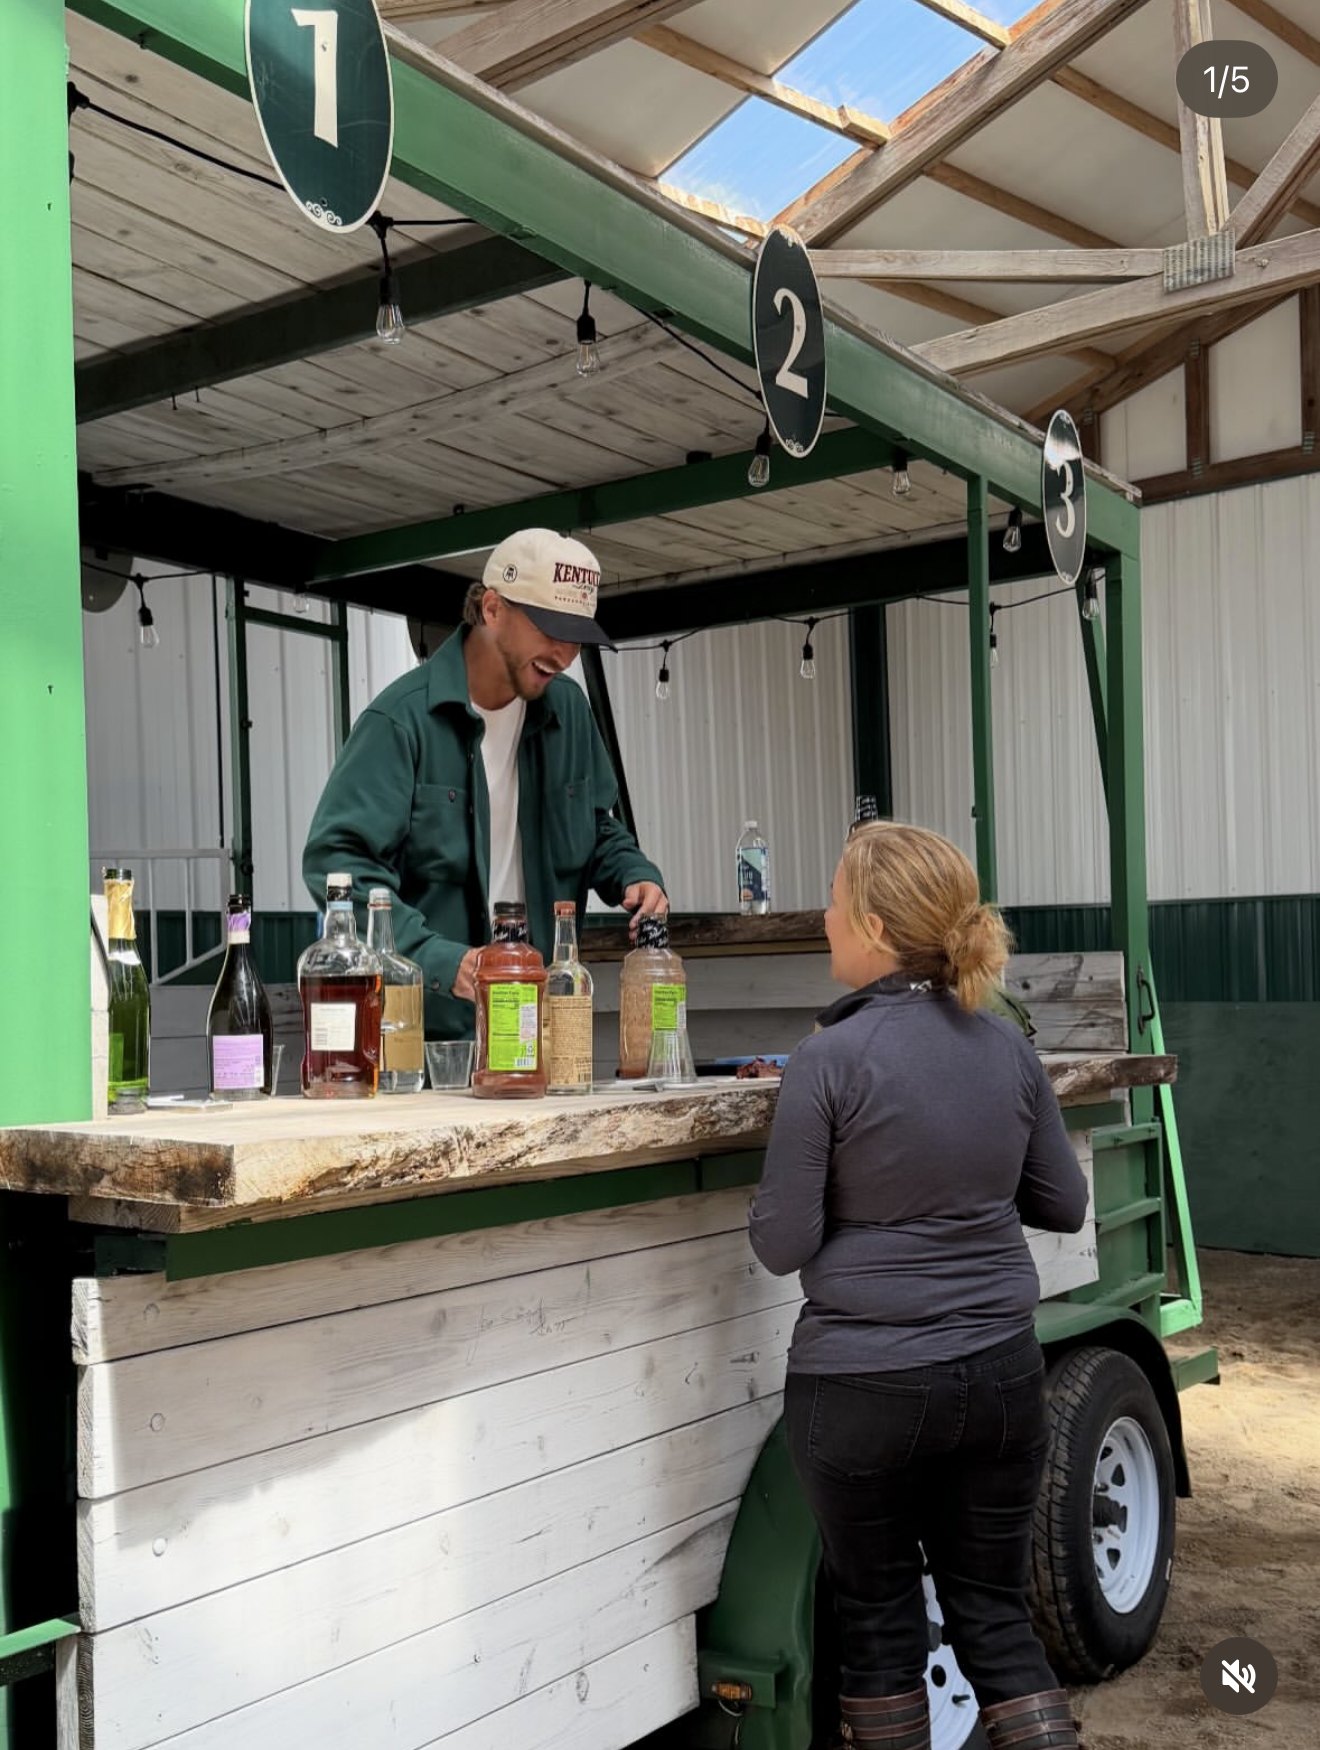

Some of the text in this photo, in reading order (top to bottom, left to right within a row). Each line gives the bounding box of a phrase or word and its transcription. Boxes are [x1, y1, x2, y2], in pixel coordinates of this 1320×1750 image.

[290, 8, 338, 148] 1
[773, 287, 809, 399] 2
[1055, 459, 1076, 539] 3
